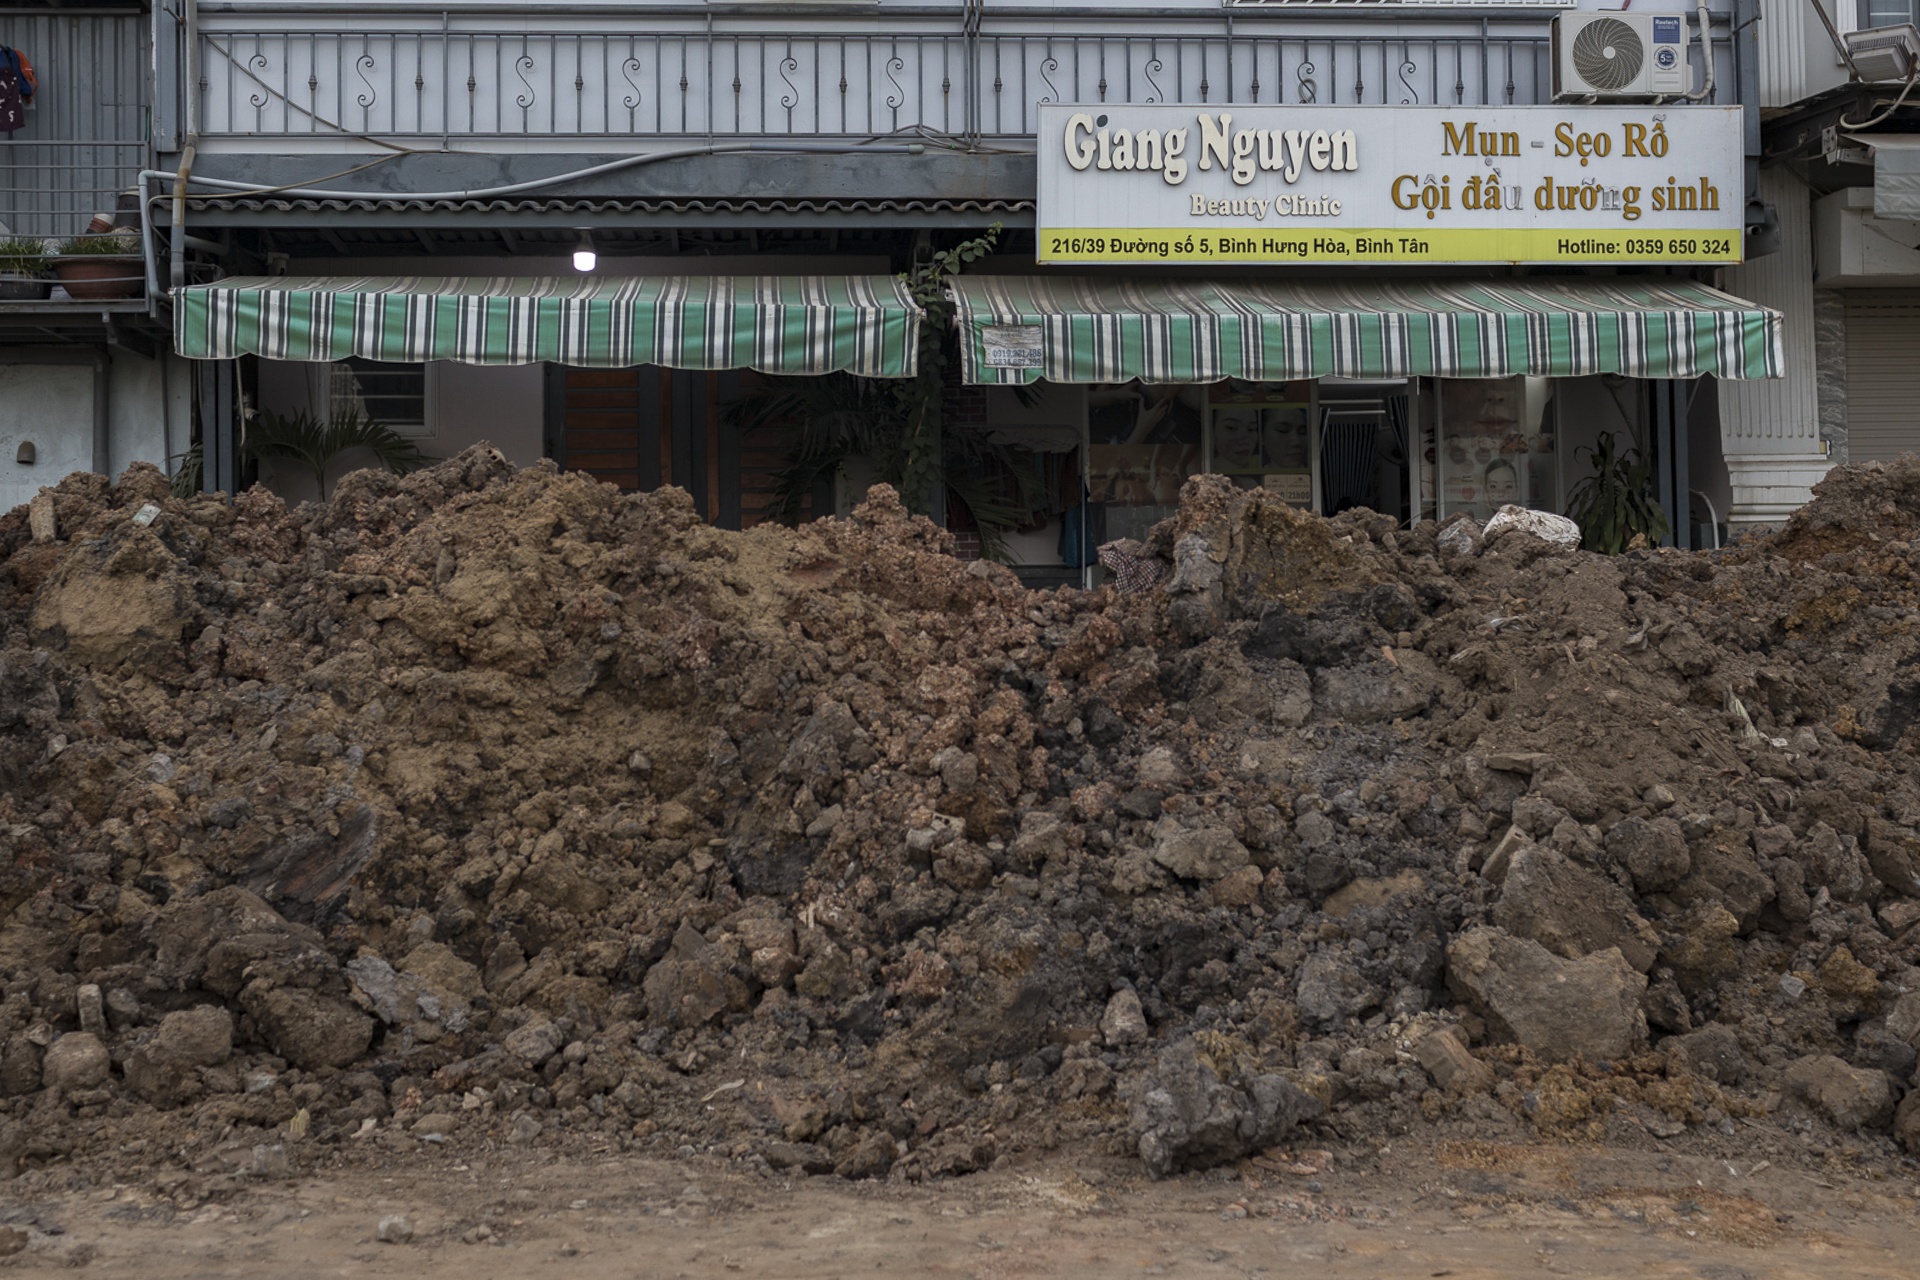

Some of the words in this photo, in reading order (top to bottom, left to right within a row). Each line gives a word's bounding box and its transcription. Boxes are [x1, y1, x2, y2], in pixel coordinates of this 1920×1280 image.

[1065, 112, 1189, 186] Giang
[1197, 112, 1359, 186] Nguyen
[1441, 121, 1520, 166] Mụn
[1555, 122, 1612, 166] Sẹo
[1622, 114, 1669, 158] Rỗ
[1190, 193, 1270, 221] Beauty
[1275, 193, 1342, 216] Clinic
[1391, 173, 1452, 219] Gội
[1462, 168, 1523, 211] đầu
[1535, 176, 1641, 221] dưỡng
[1652, 177, 1719, 211] sinh
[1052, 238, 1106, 254] 216/39
[1109, 237, 1169, 257] Đường
[1174, 234, 1195, 254] số
[1199, 238, 1214, 256] 5,
[1218, 237, 1257, 254] Bình
[1263, 238, 1308, 258] Hưng
[1313, 237, 1350, 256] Hòa,
[1355, 237, 1394, 254] Bình
[1398, 237, 1429, 254] Tân
[1557, 239, 1620, 254] Hotline:
[1625, 239, 1664, 254] 0359
[1668, 239, 1697, 254] 650
[1702, 239, 1731, 254] 324
